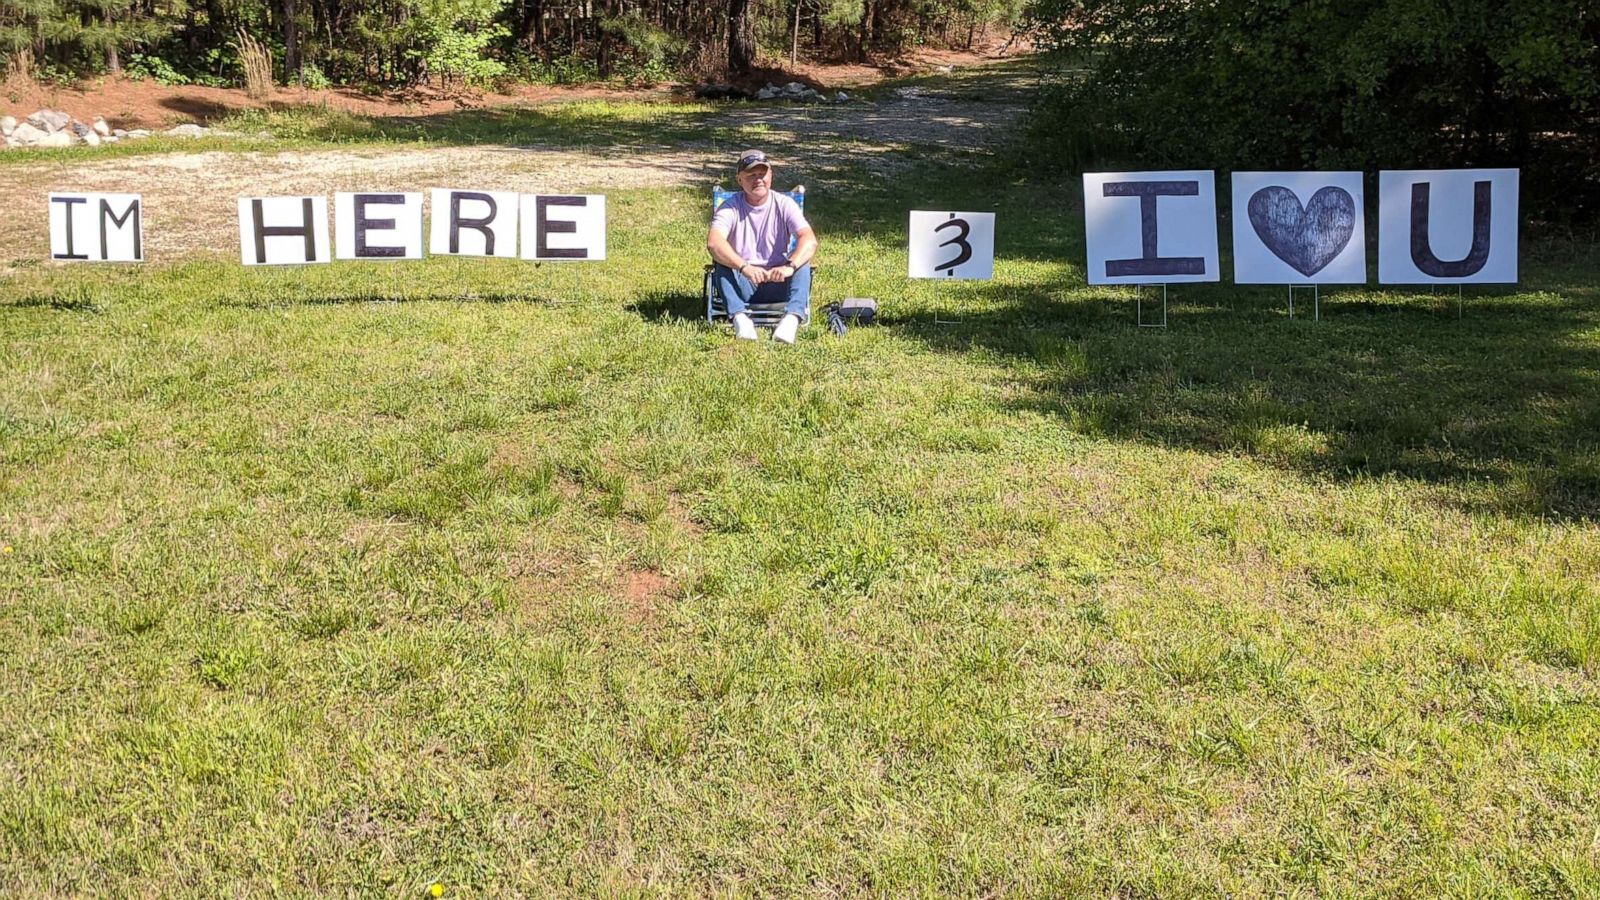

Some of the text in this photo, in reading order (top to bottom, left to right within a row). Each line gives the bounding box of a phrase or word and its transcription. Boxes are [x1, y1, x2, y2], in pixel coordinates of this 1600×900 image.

[51, 197, 141, 259] IM
[1102, 180, 1492, 278] I U
